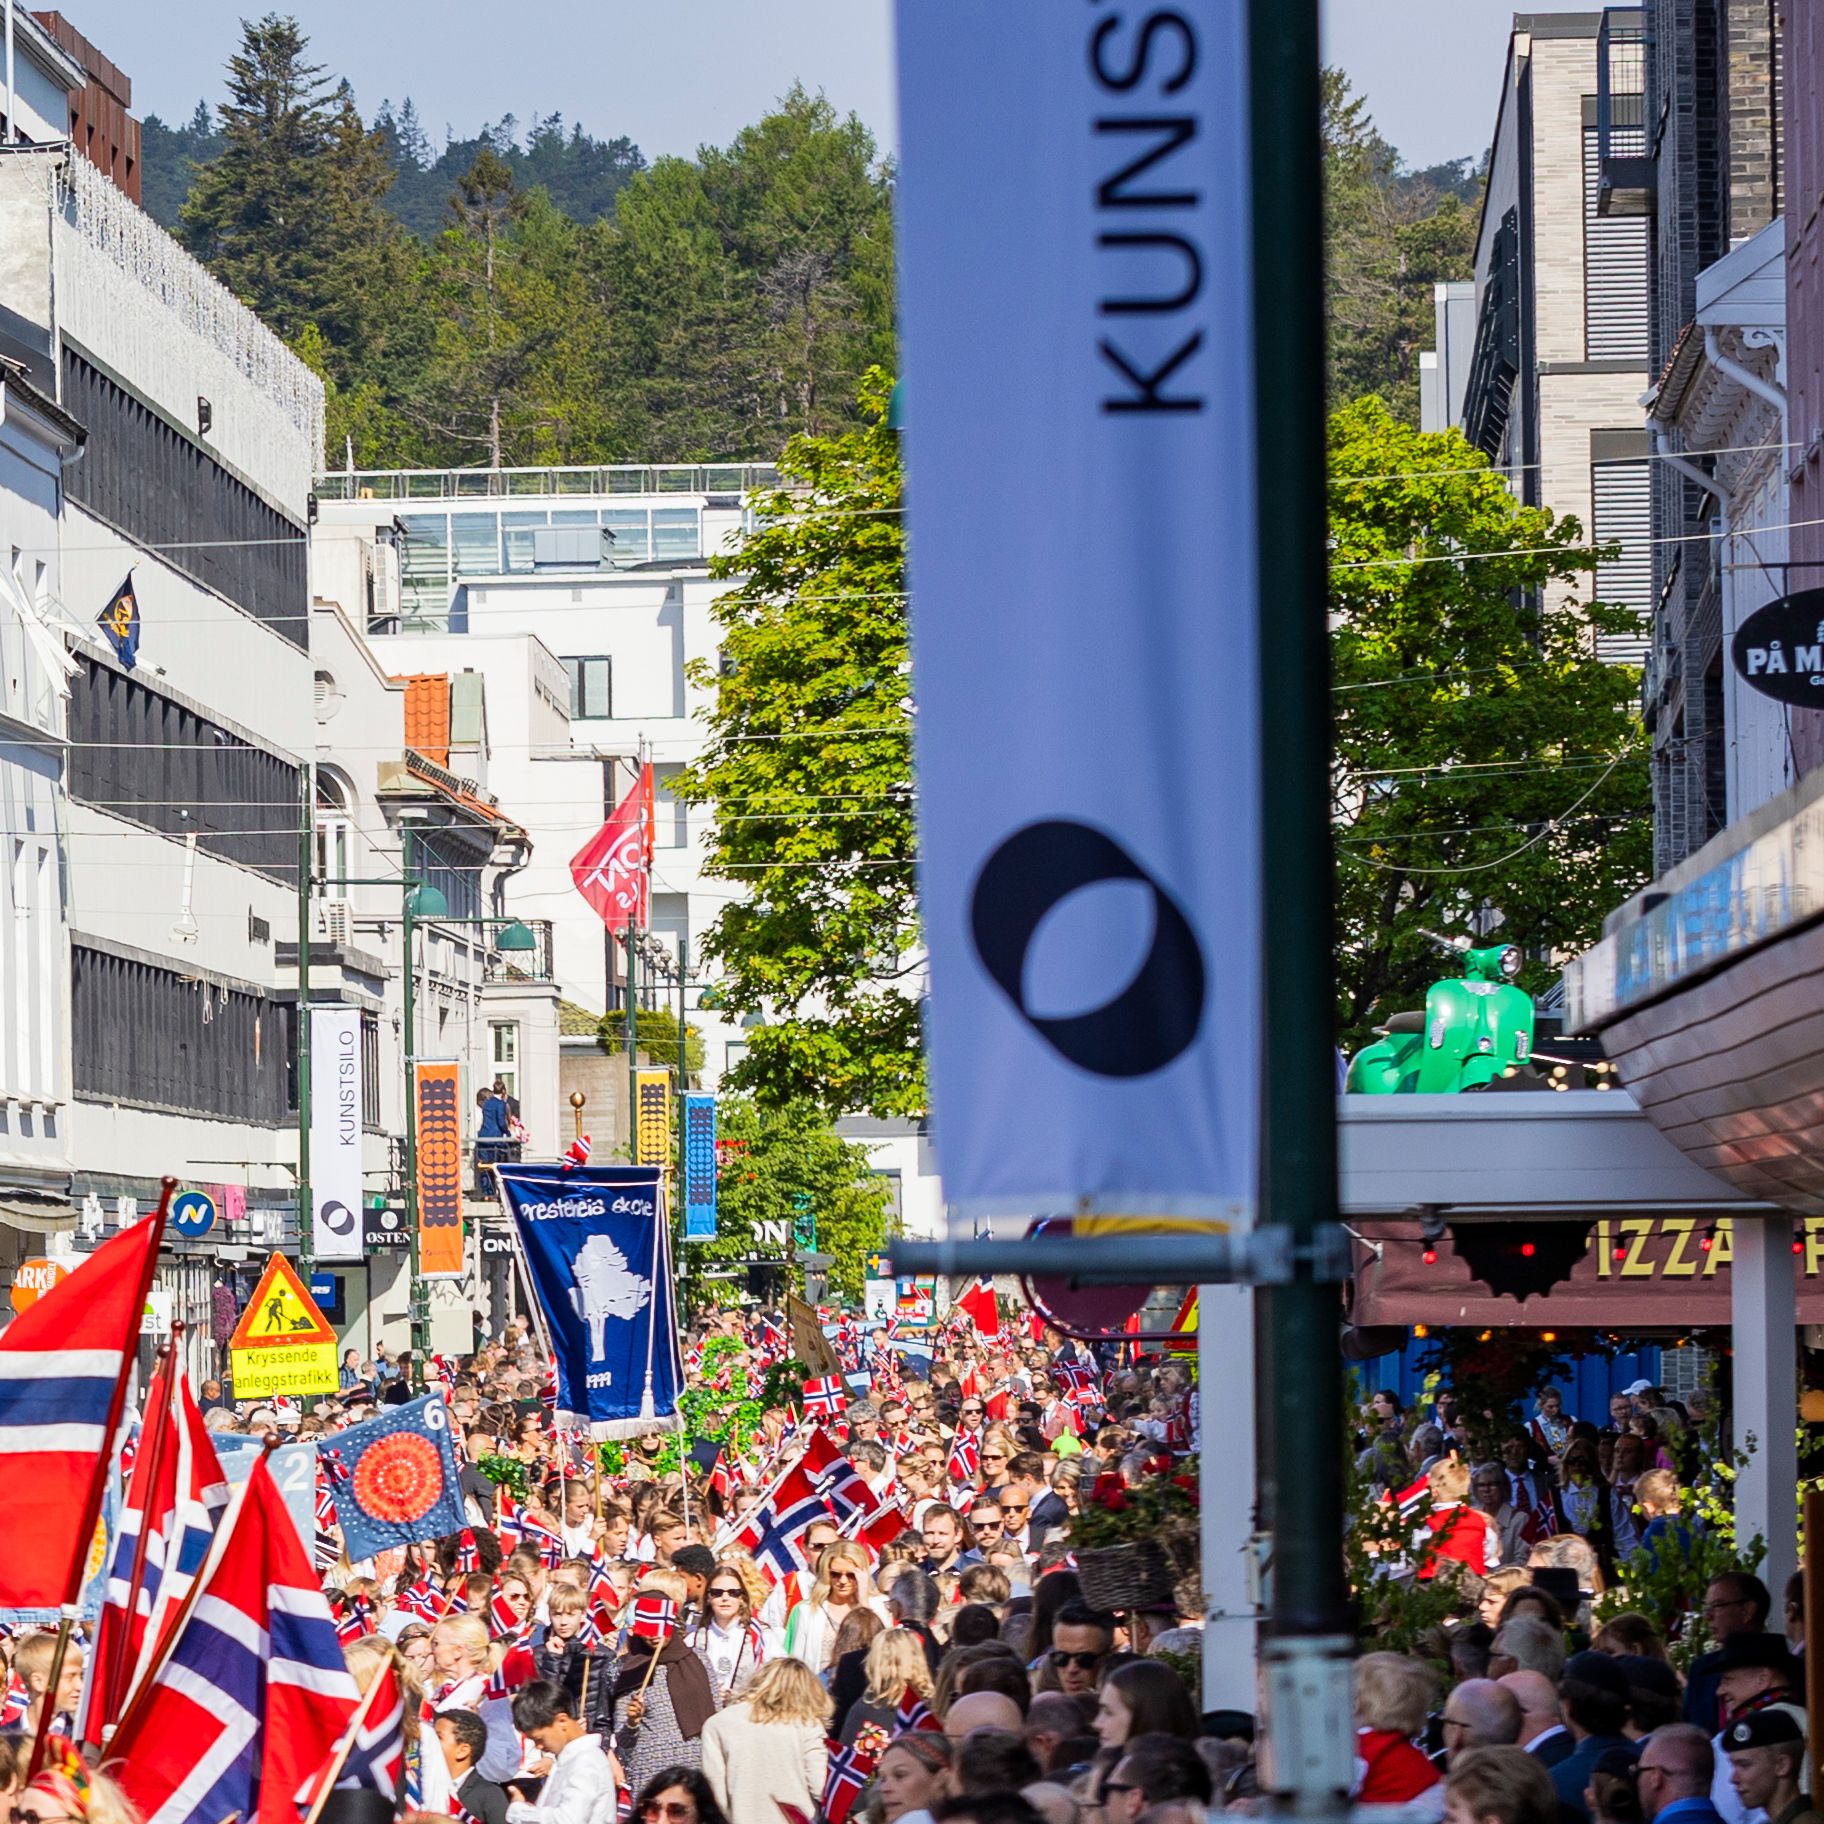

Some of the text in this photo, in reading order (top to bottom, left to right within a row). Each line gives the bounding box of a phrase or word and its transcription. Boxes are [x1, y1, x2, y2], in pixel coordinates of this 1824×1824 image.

[1090, 0, 1207, 414] KUNS
[1746, 640, 1824, 675] PÅ M
[340, 1030, 355, 1146] KUNSTSILO
[1585, 1218, 1734, 1276] IZZA
[247, 1349, 318, 1367] Kryssende
[234, 1371, 333, 1391] anleggstrafikk
[586, 1371, 611, 1388] 1999
[423, 1400, 446, 1430] 6
[284, 1450, 309, 1491] 2
